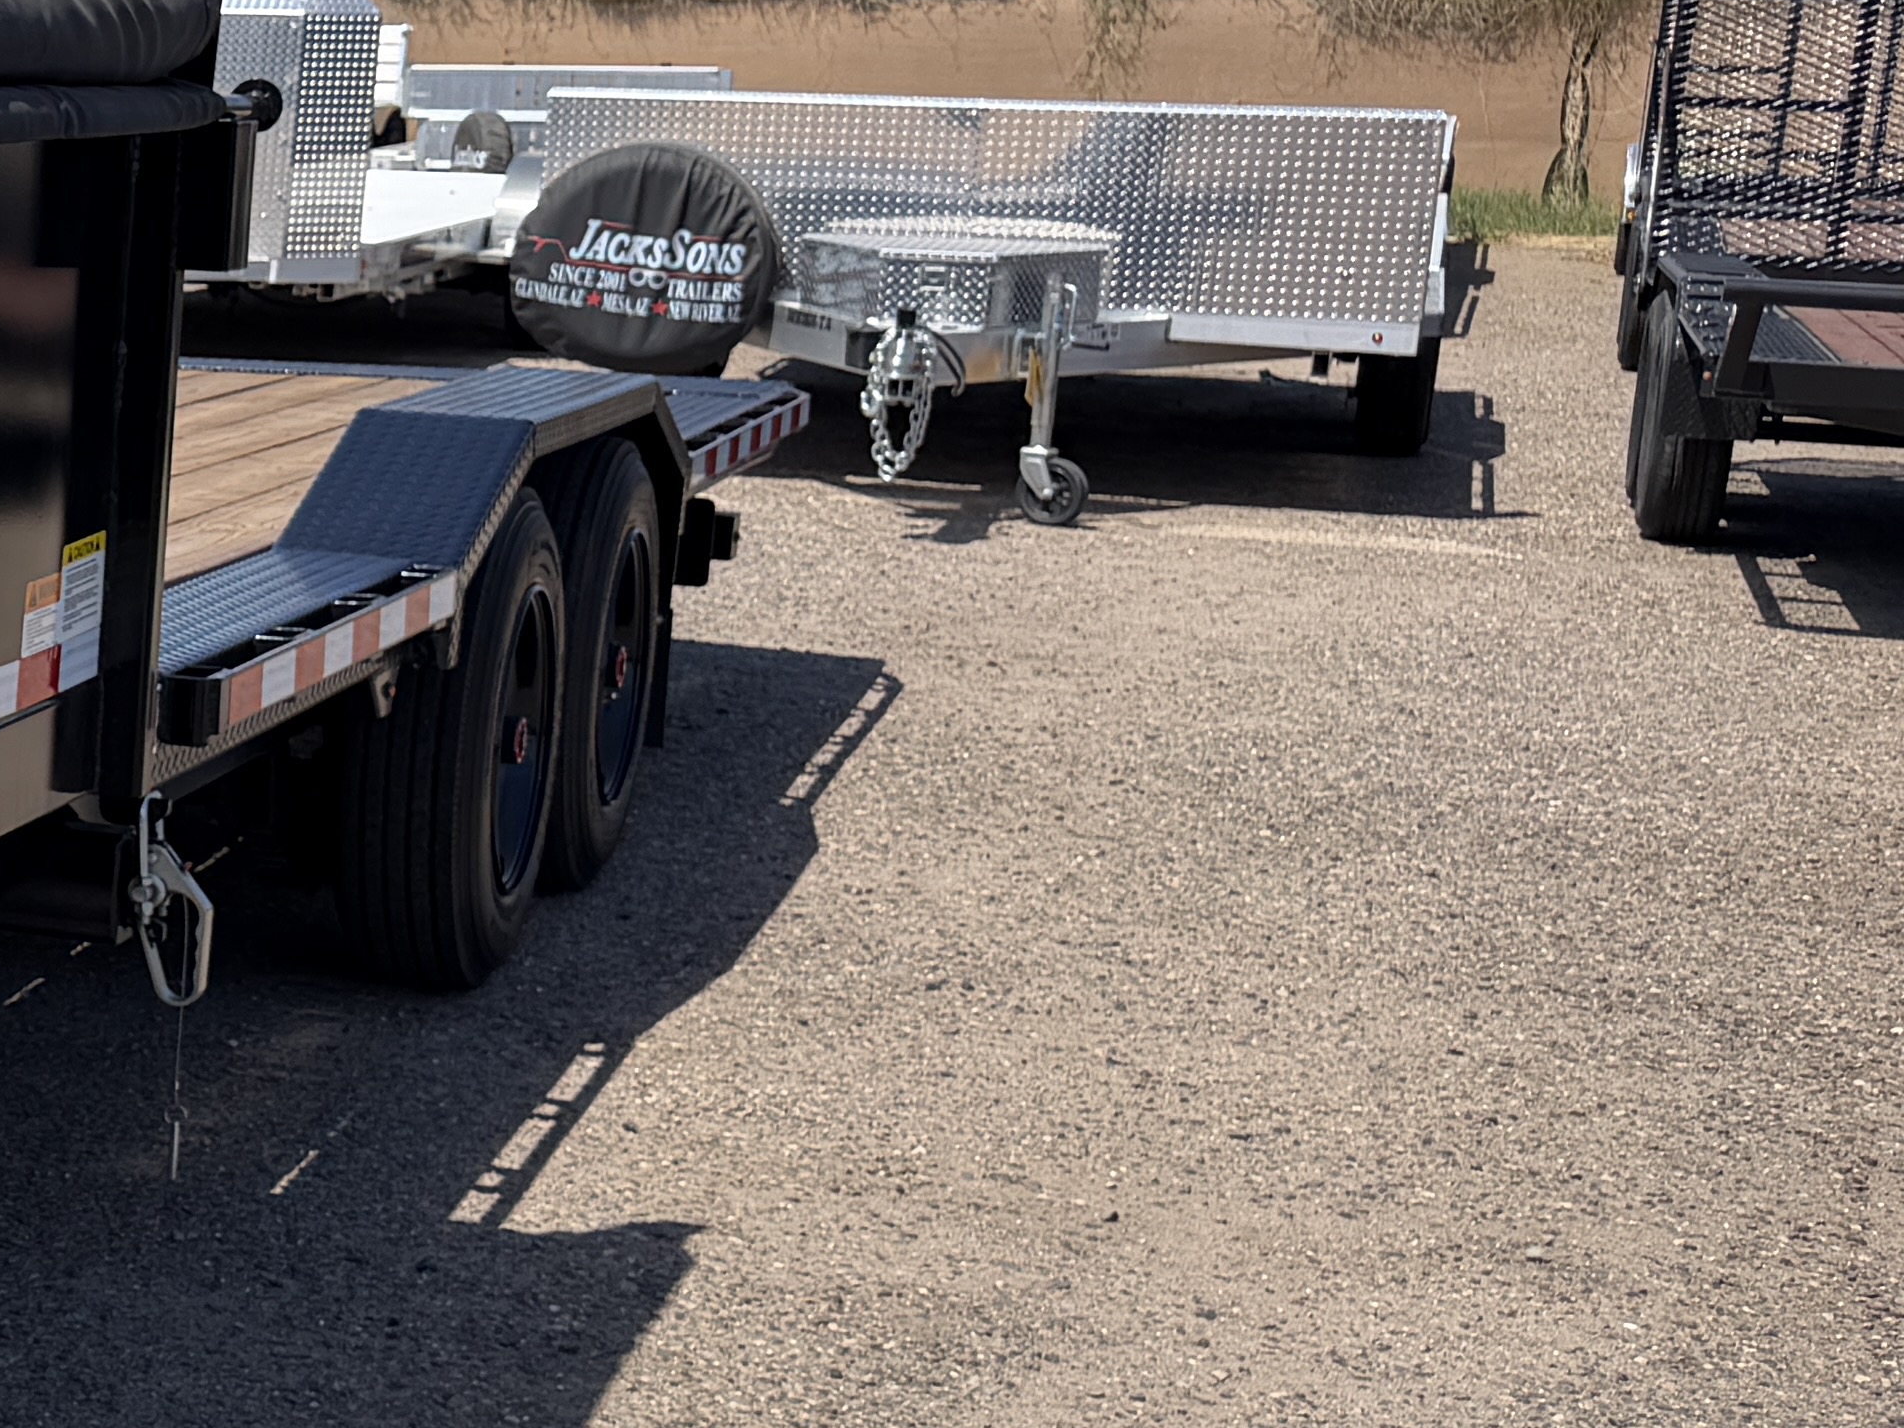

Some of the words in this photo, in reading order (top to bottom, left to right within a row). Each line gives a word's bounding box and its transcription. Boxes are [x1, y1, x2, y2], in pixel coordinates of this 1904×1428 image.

[548, 262, 595, 288] SINCE
[596, 269, 626, 292] 2001
[667, 278, 743, 302] TRAILERS
